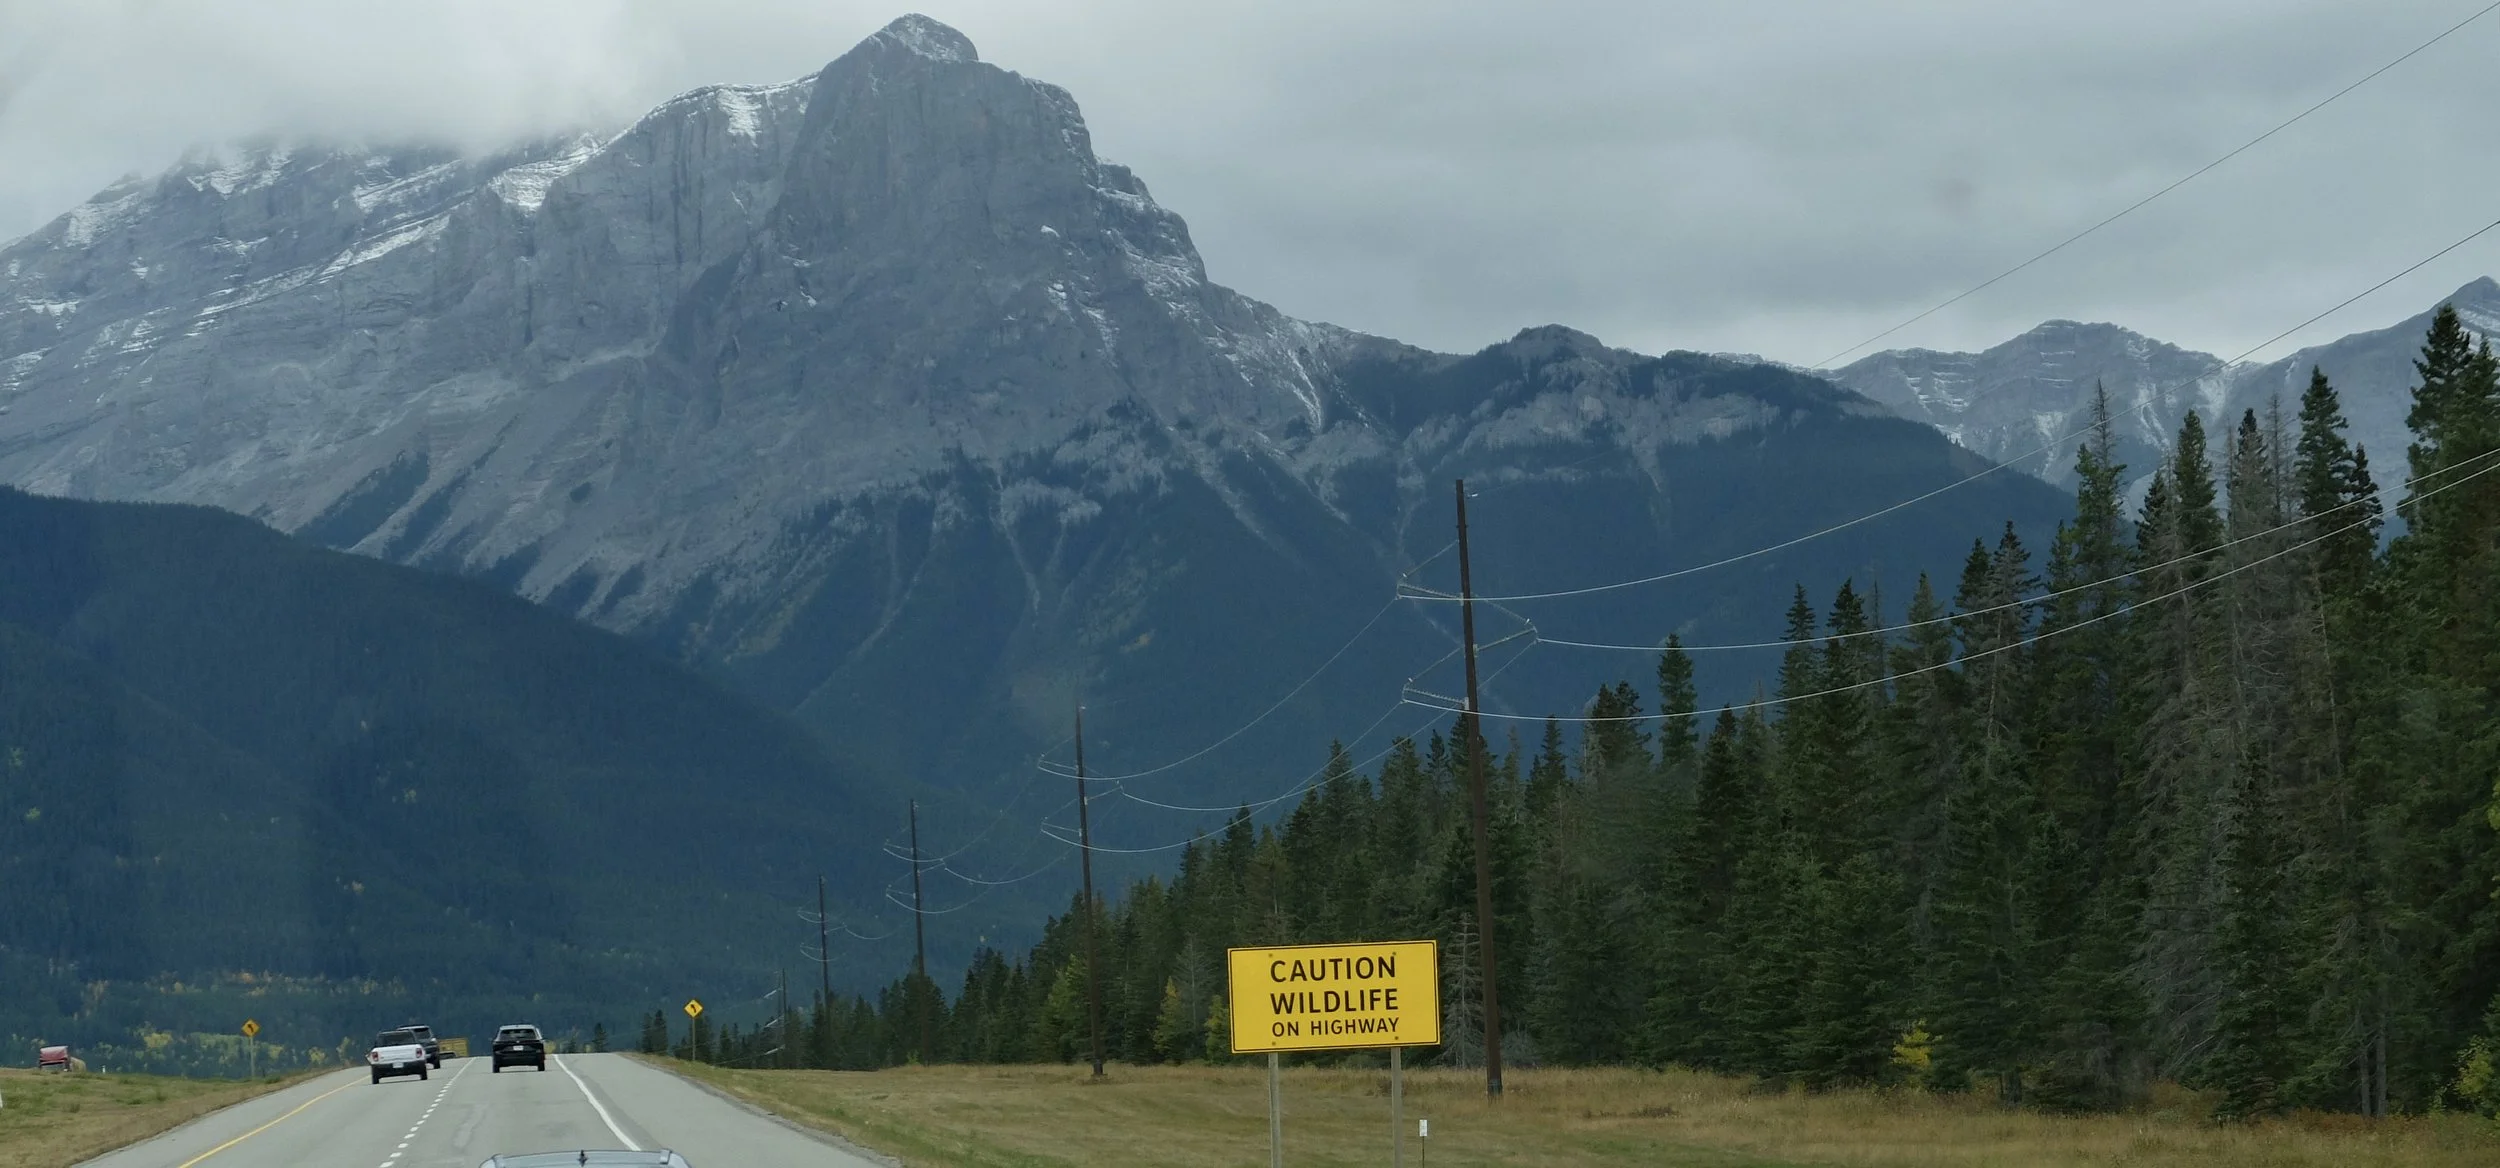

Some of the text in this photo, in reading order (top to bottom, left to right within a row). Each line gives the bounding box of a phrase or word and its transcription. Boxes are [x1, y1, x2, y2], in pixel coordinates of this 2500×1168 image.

[1271, 956, 1396, 982] CAUTION
[1270, 988, 1399, 1015] WILDLIFE
[1272, 1017, 1399, 1037] ON HIGHWAY
